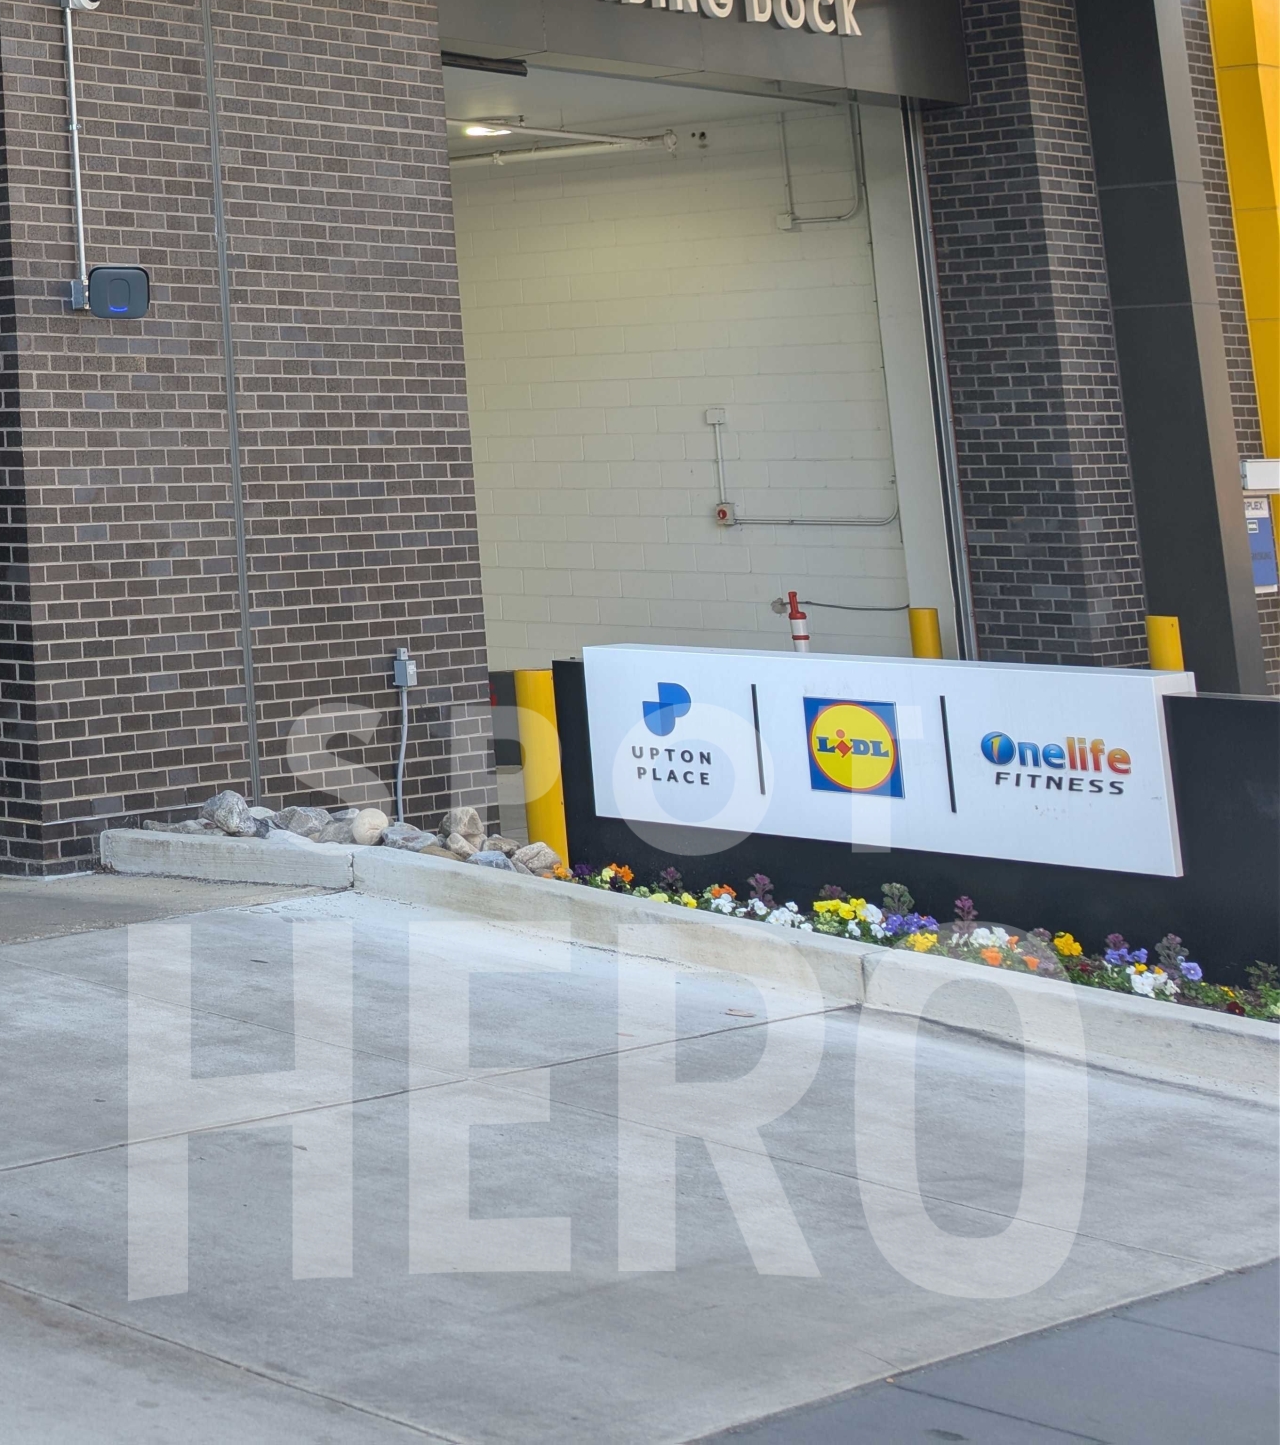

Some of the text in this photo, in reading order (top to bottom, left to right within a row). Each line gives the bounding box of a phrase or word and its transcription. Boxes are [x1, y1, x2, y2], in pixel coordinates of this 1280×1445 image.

[1244, 501, 1264, 511] PLEX
[631, 745, 712, 765] UPTON
[981, 731, 1132, 775] Onelife
[637, 766, 710, 785] PLACE
[995, 771, 1124, 795] FITNESS
